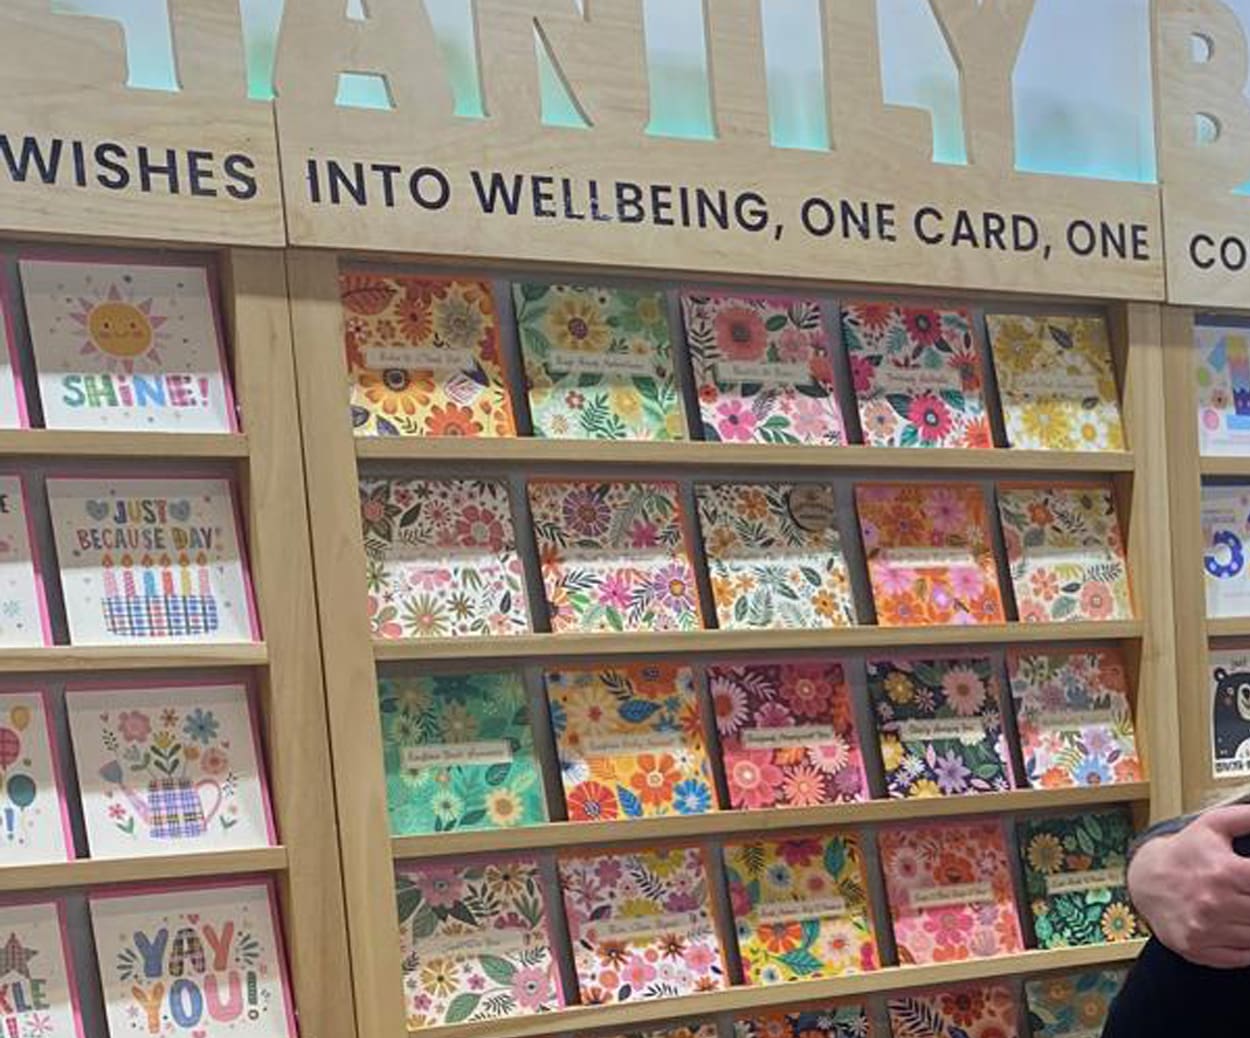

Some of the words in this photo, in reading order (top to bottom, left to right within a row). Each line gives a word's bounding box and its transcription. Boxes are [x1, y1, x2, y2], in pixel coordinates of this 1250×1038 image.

[0, 134, 257, 200] WISHES
[308, 157, 451, 210] INTO
[471, 170, 783, 241] WELLBEING,
[801, 197, 897, 242] ONE
[914, 206, 1051, 260] CARD,
[1066, 219, 1150, 261] ONE
[76, 527, 166, 551] BECAUSE
[113, 499, 168, 525] JUST
[134, 921, 234, 978] YAY
[132, 970, 260, 1034] YOU!
